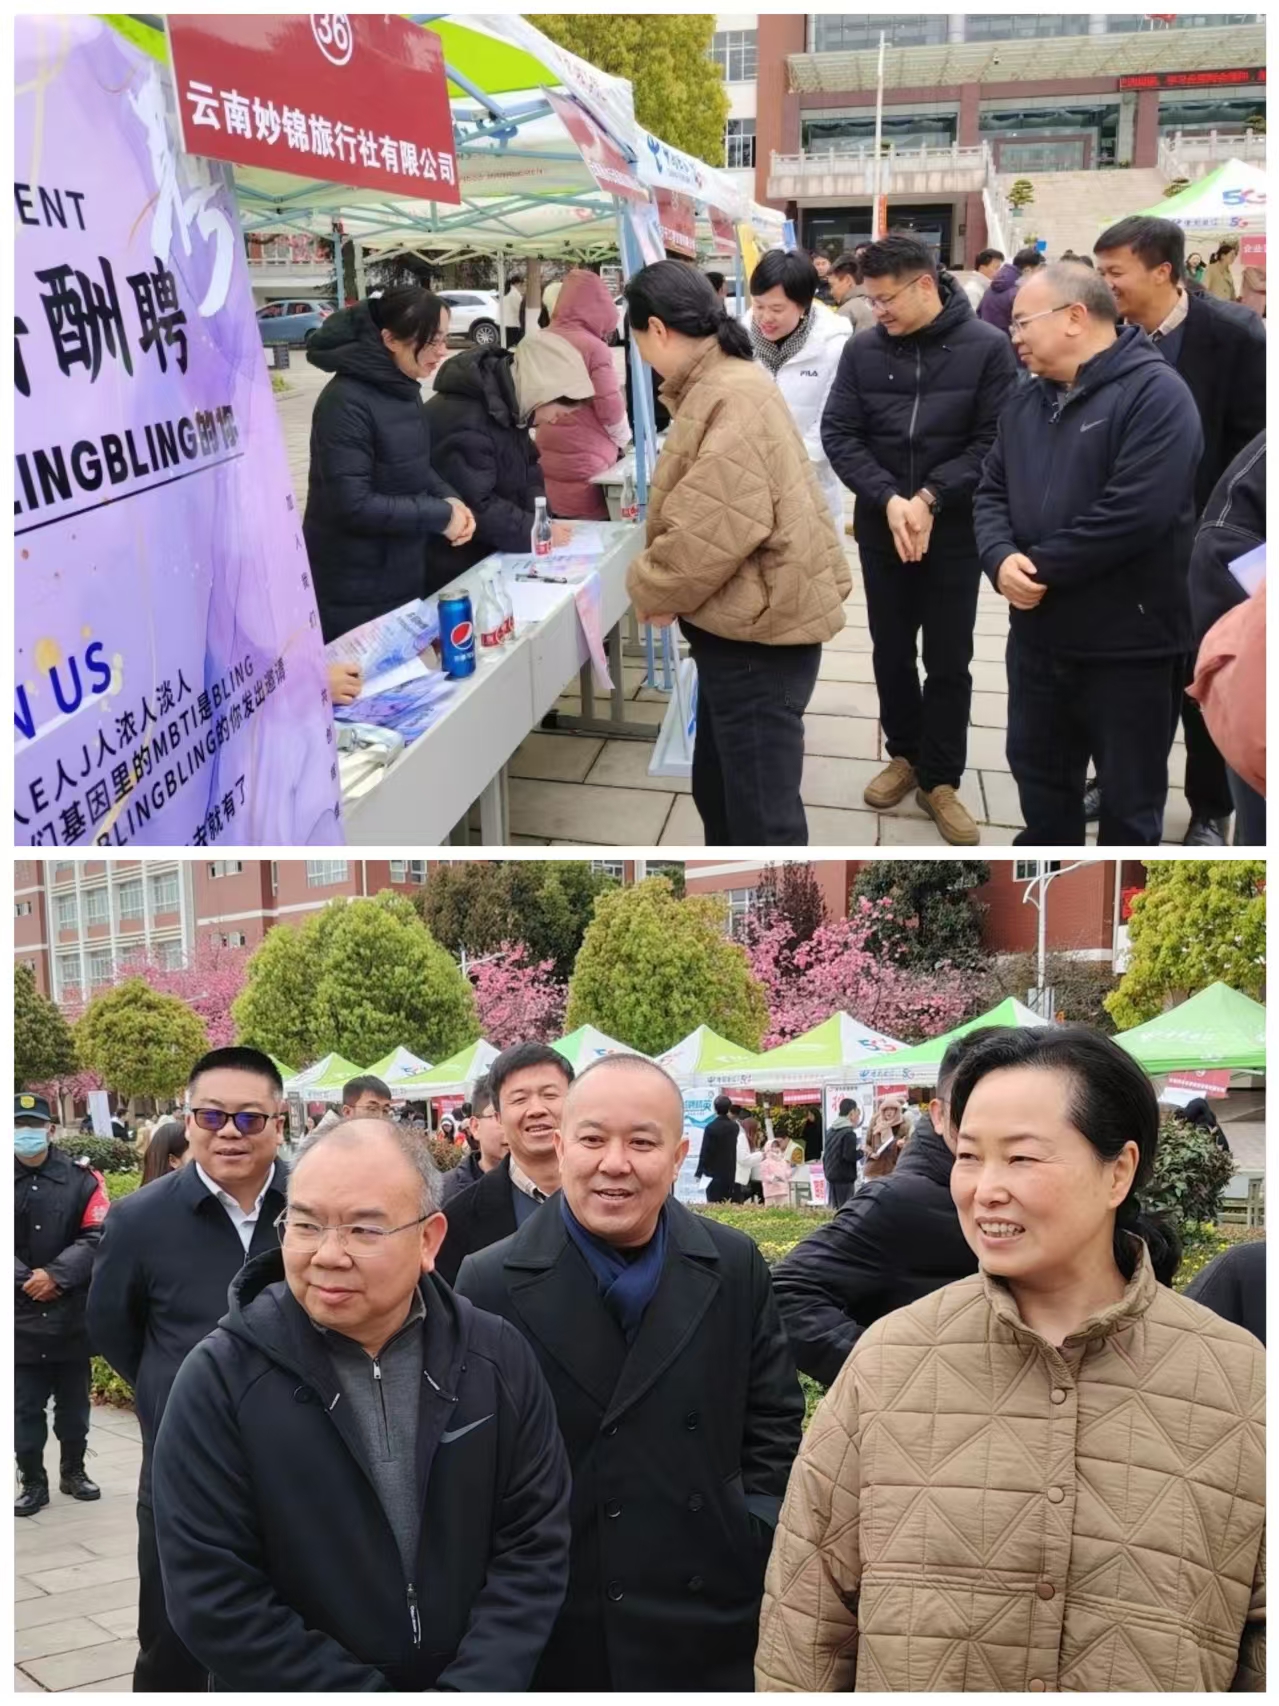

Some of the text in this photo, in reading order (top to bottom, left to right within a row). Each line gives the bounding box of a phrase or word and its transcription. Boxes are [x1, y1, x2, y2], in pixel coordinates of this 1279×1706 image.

[317, 14, 349, 51] 36
[186, 80, 456, 186] 云南妙锦旅行社有限公司
[14, 182, 86, 231] ENT
[1243, 243, 1266, 255] 企业
[14, 405, 239, 516] INGBLING的你
[49, 641, 112, 714] US
